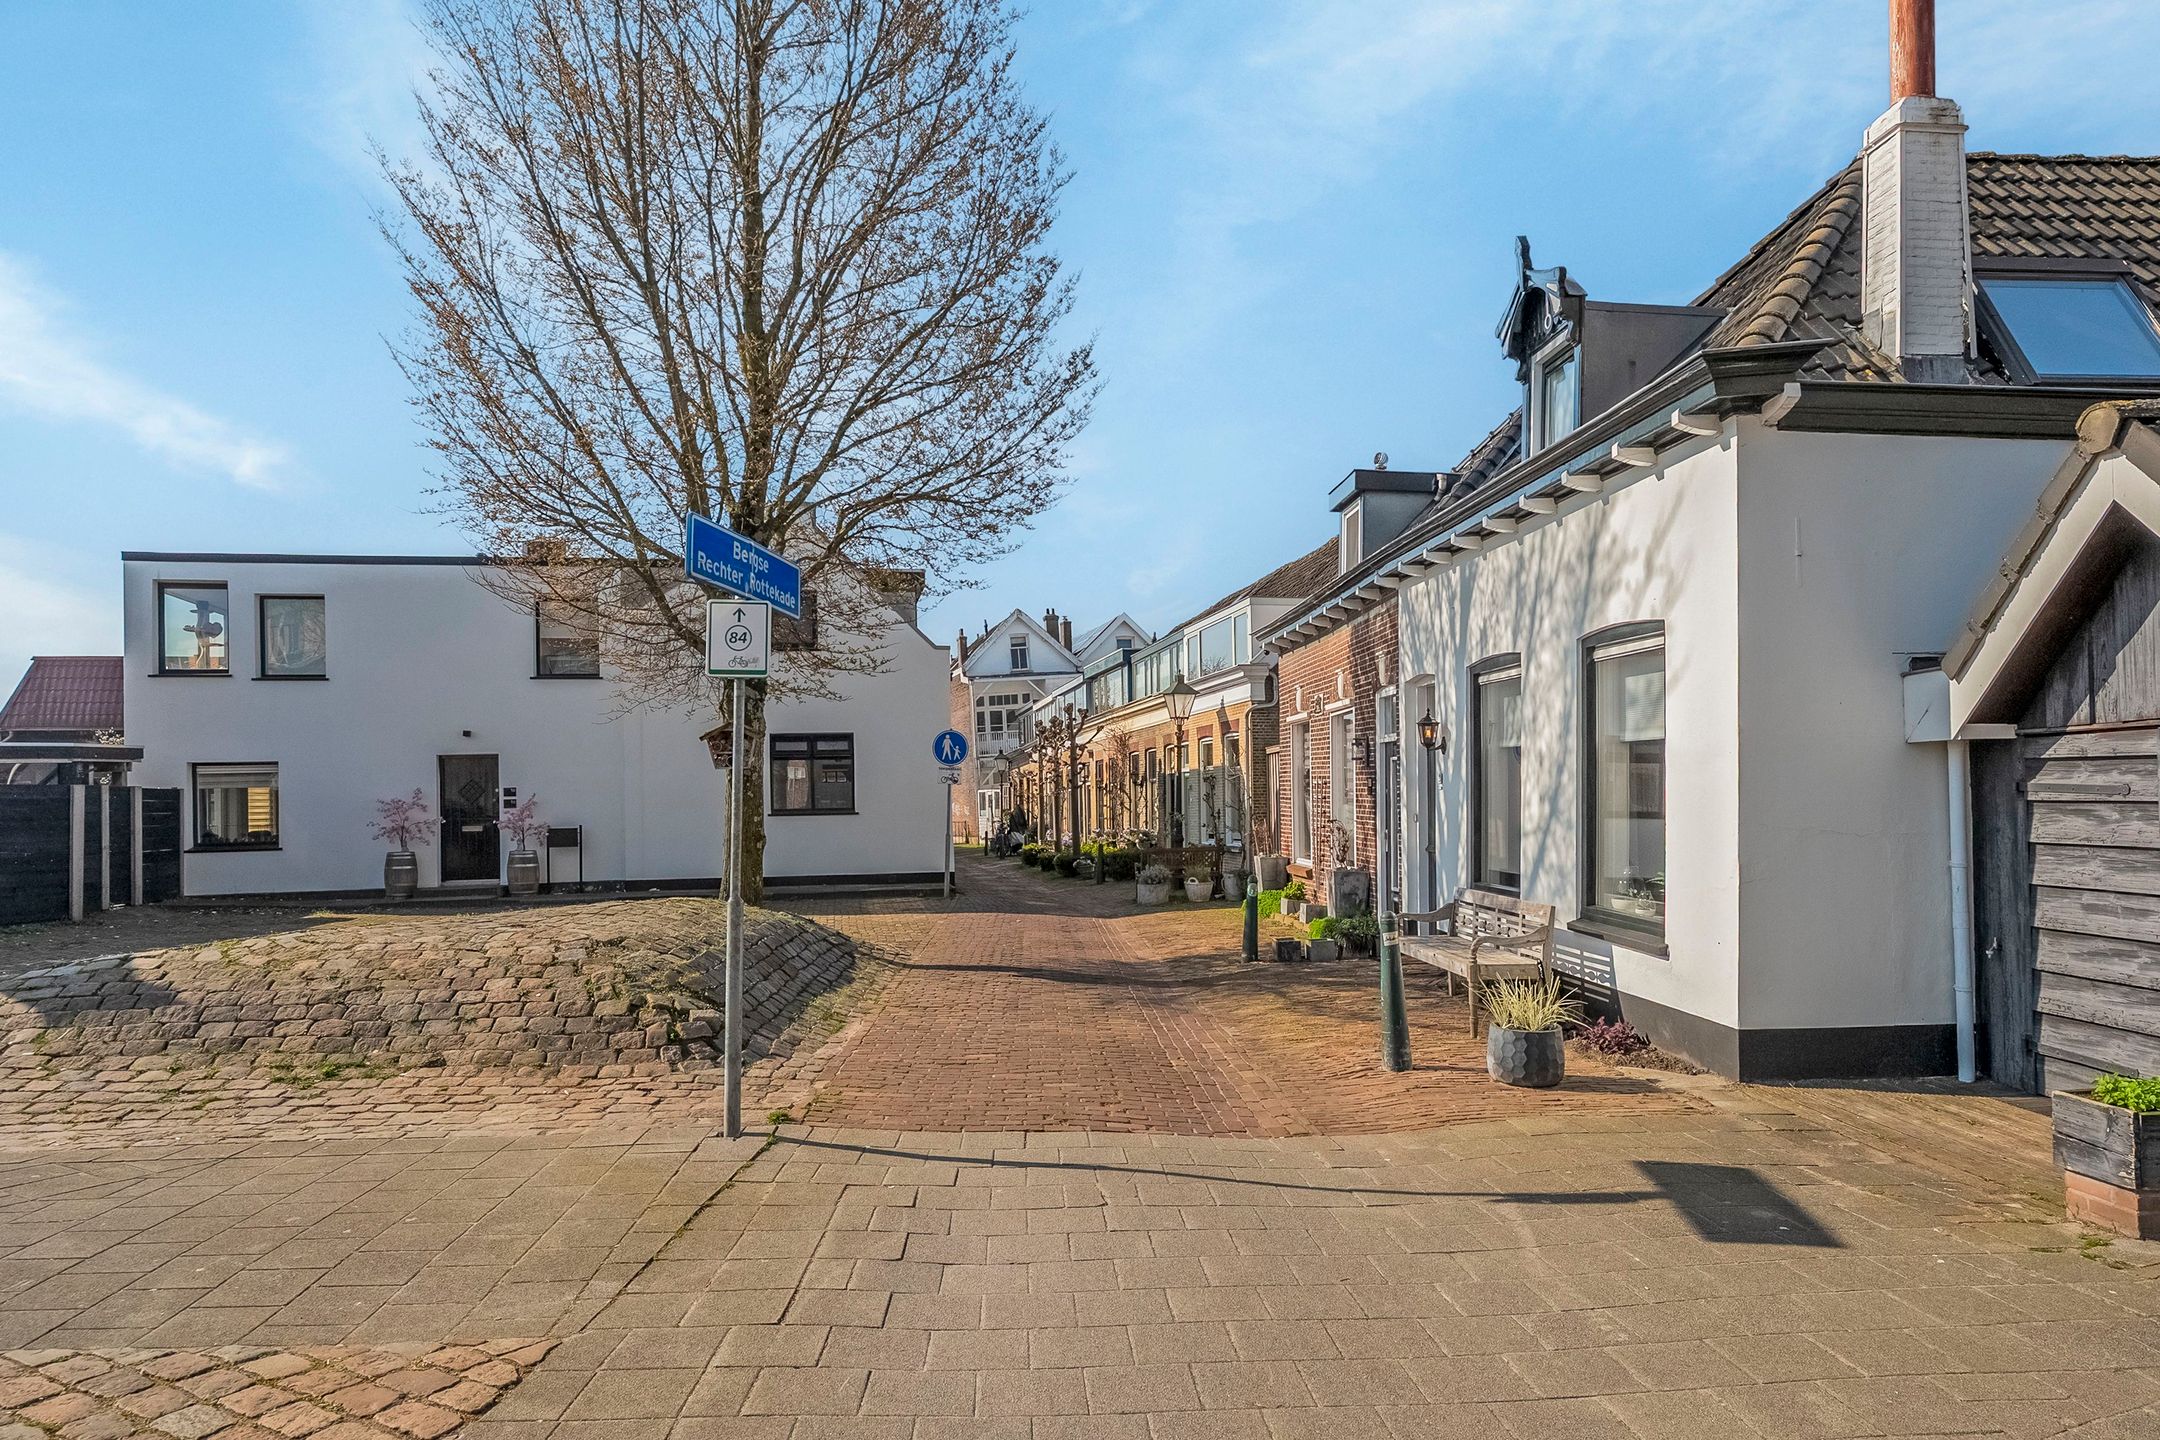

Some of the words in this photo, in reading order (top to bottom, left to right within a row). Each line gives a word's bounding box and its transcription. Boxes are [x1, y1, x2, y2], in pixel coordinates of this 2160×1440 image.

[733, 541, 769, 573] Bergse
[697, 550, 743, 585] Rechter
[749, 572, 796, 609] Rottekade
[729, 631, 748, 643] 84
